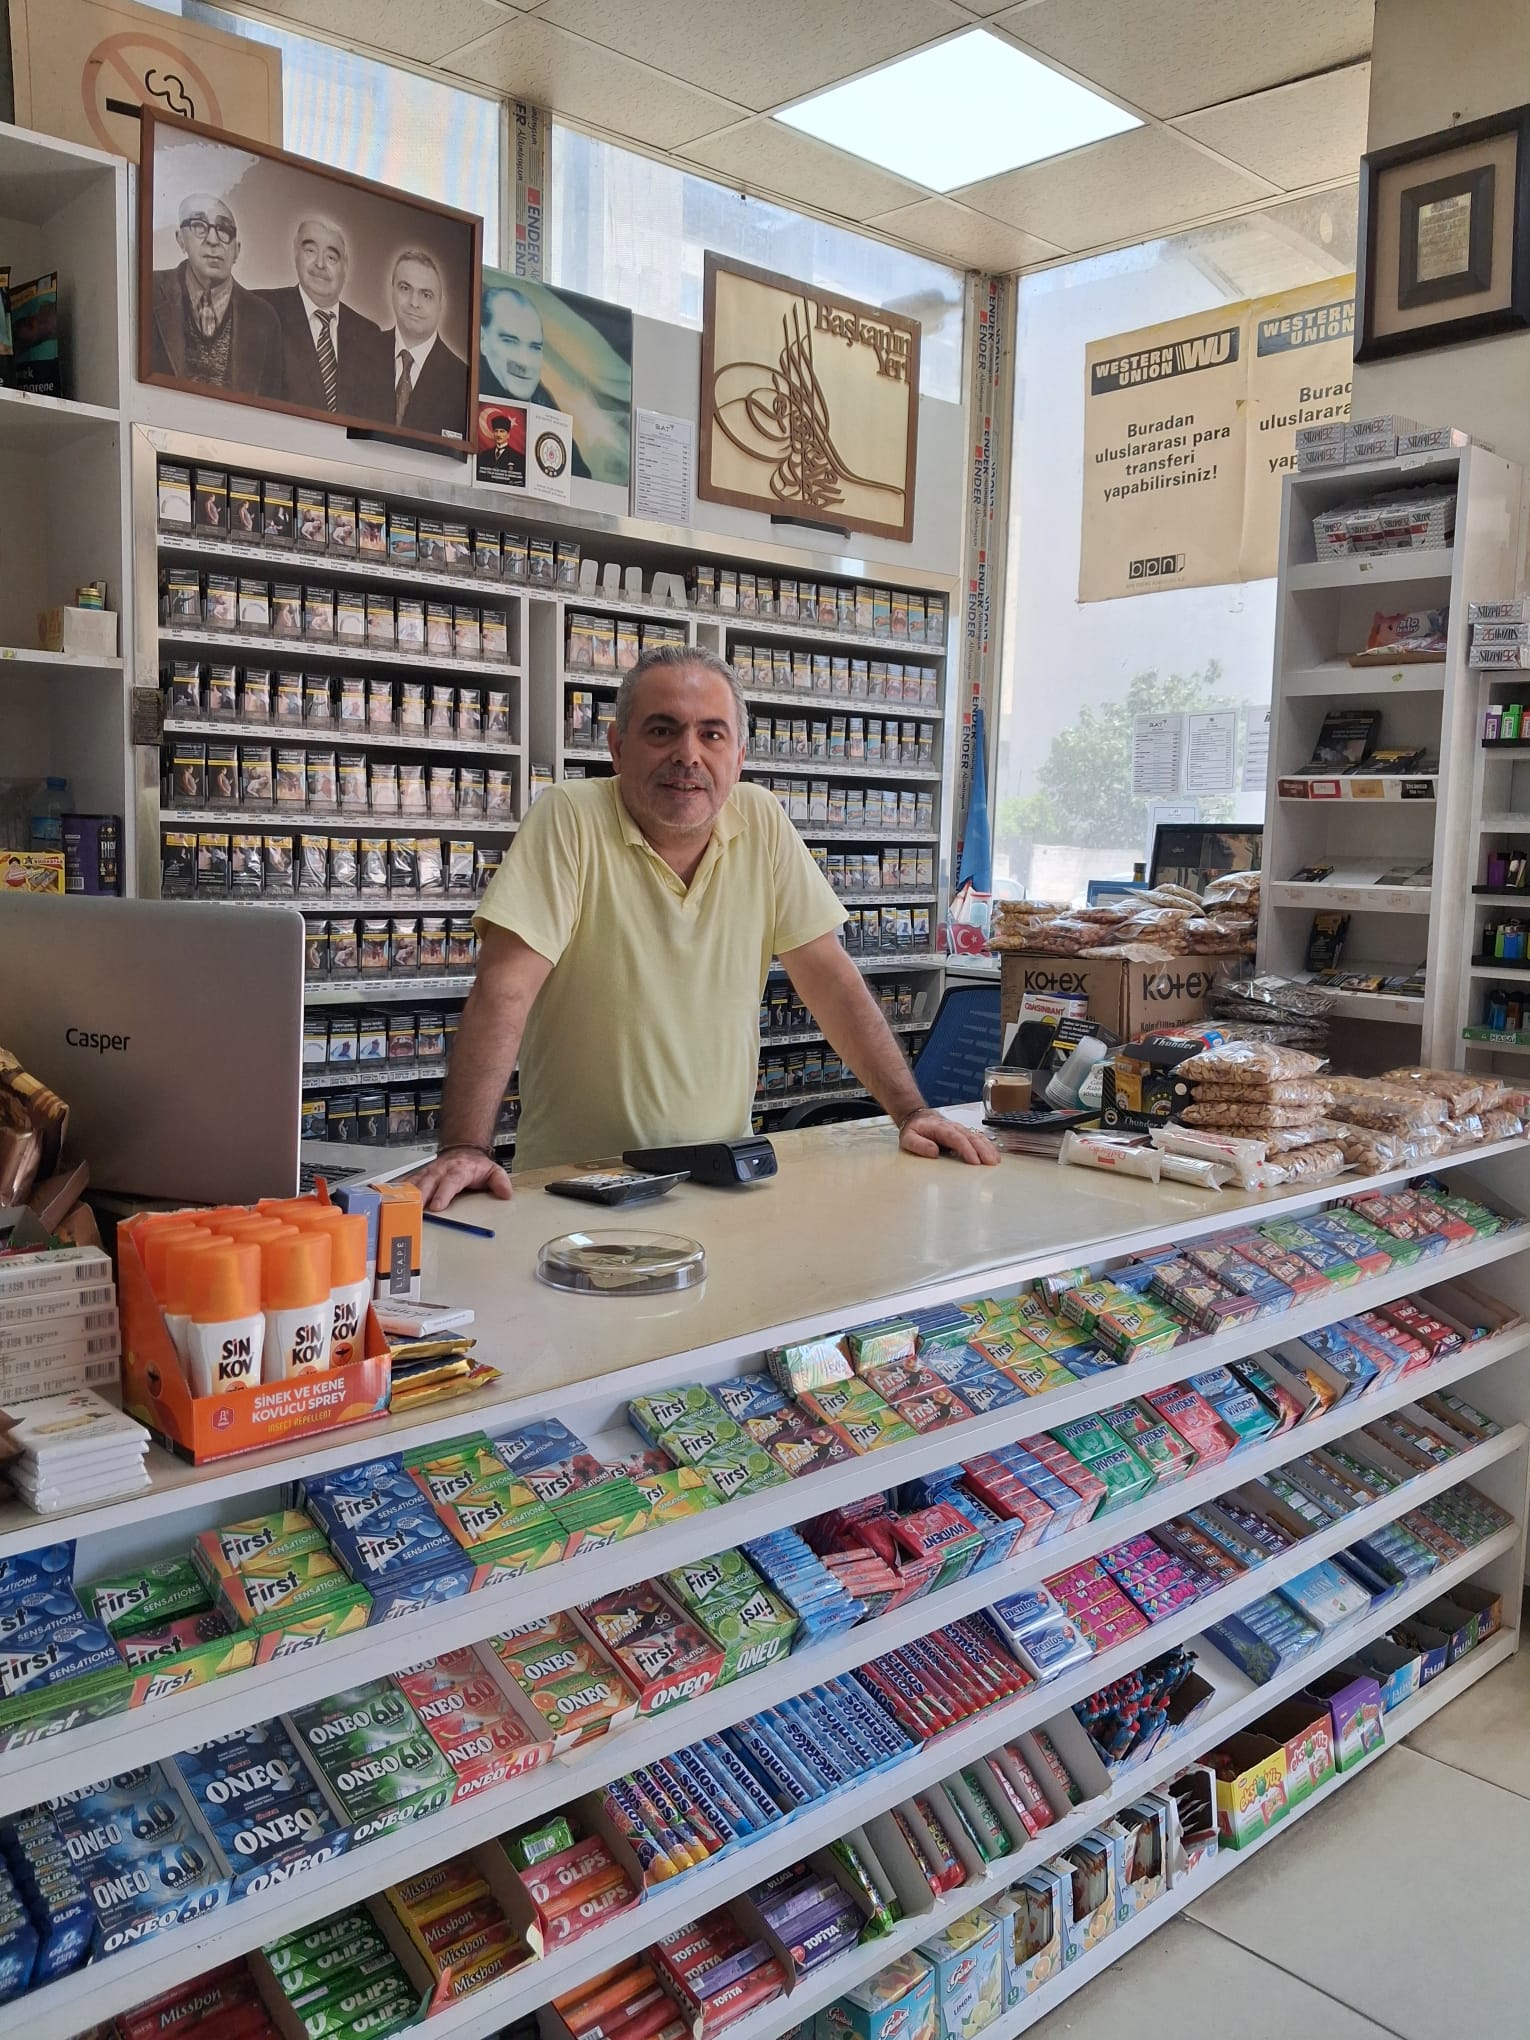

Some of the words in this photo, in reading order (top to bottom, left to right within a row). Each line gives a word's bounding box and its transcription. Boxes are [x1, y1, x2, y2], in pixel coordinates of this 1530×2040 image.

[1096, 346, 1173, 378] WESTERN
[1119, 362, 1173, 386] UNION
[1127, 414, 1194, 439] Buradan
[1095, 435, 1187, 463] uluslararası
[1193, 426, 1231, 448] para
[1125, 448, 1196, 476] transferi
[1104, 465, 1218, 503] yapabilirsiniz!
[65, 1027, 131, 1053] Casper
[1152, 1036, 1197, 1050] Thunder
[1124, 1115, 1158, 1128] Thunder
[292, 1343, 325, 1366] KOV
[989, 1339, 1015, 1361] First
[218, 1357, 254, 1380] KOV
[876, 1364, 908, 1391] First
[1019, 1367, 1046, 1386] First
[294, 1386, 312, 1398] VE
[313, 1378, 344, 1394] KENE
[720, 1385, 754, 1410] First
[818, 1389, 850, 1411] First
[252, 1402, 306, 1423] KOVUCU
[308, 1391, 346, 1411] SPREY
[651, 1397, 686, 1424] First
[905, 1397, 938, 1422] First
[1165, 1395, 1199, 1415] VIVIDENT
[1224, 1397, 1257, 1418] VIVIDENT
[680, 1429, 717, 1455] First
[849, 1419, 881, 1443] First
[1061, 1417, 1100, 1438] VIVIDENT
[1134, 1426, 1170, 1447] VIVIDENT
[498, 1436, 528, 1461] First
[1092, 1448, 1130, 1472] VIVIDENT
[429, 1470, 474, 1500] First
[712, 1462, 750, 1490] First
[334, 1491, 381, 1522] First
[378, 1494, 426, 1520] SENSATIONS
[459, 1500, 505, 1533] First
[221, 1527, 273, 1561] First
[358, 1529, 408, 1564] First
[402, 1535, 450, 1561] SENSATIONS
[573, 1530, 617, 1557] First
[922, 1522, 970, 1549] VIVIDENT
[244, 1571, 298, 1607] First
[483, 1561, 528, 1588] First
[685, 1564, 722, 1593] First
[93, 1579, 151, 1619] First
[143, 1584, 202, 1614] SENSATIONS
[740, 1598, 775, 1627] First
[1003, 1599, 1038, 1619] mentos
[18, 1612, 82, 1642] SENSATIONS
[655, 1613, 671, 1624] 60
[271, 1628, 326, 1660] First
[636, 1641, 674, 1670] First
[737, 1637, 780, 1671] ONEO
[1030, 1633, 1064, 1657] mentos
[49, 1647, 116, 1681] SENSATIONS
[525, 1650, 577, 1680] ONEO
[888, 1653, 925, 1693] entos
[144, 1669, 194, 1704] First
[557, 1682, 612, 1714] ONEO
[652, 1672, 711, 1708] ONEO
[4, 1709, 79, 1751] First
[309, 1711, 370, 1744] ONEO
[205, 1759, 289, 1804] ONEO
[337, 1755, 399, 1791] ONEO
[457, 1768, 506, 1796] ONEO
[680, 1750, 721, 1799] entos
[750, 1738, 807, 1801] mentos
[652, 1762, 692, 1814] entos
[720, 1751, 777, 1820] mentos
[354, 1805, 413, 1840] ONEO
[681, 1774, 736, 1845] mentos
[66, 1823, 123, 1864] ONEO
[234, 1808, 317, 1855] ONEO
[247, 1847, 333, 1896] ONEO
[400, 1871, 447, 1901] Missbon
[93, 1869, 150, 1909] ONEO
[103, 1911, 178, 1952] ONEO
[424, 1910, 473, 1944] Missbon
[440, 1934, 488, 1969] Missbon
[454, 1958, 503, 1995] Missbon
[160, 1988, 222, 2028] Missbon
